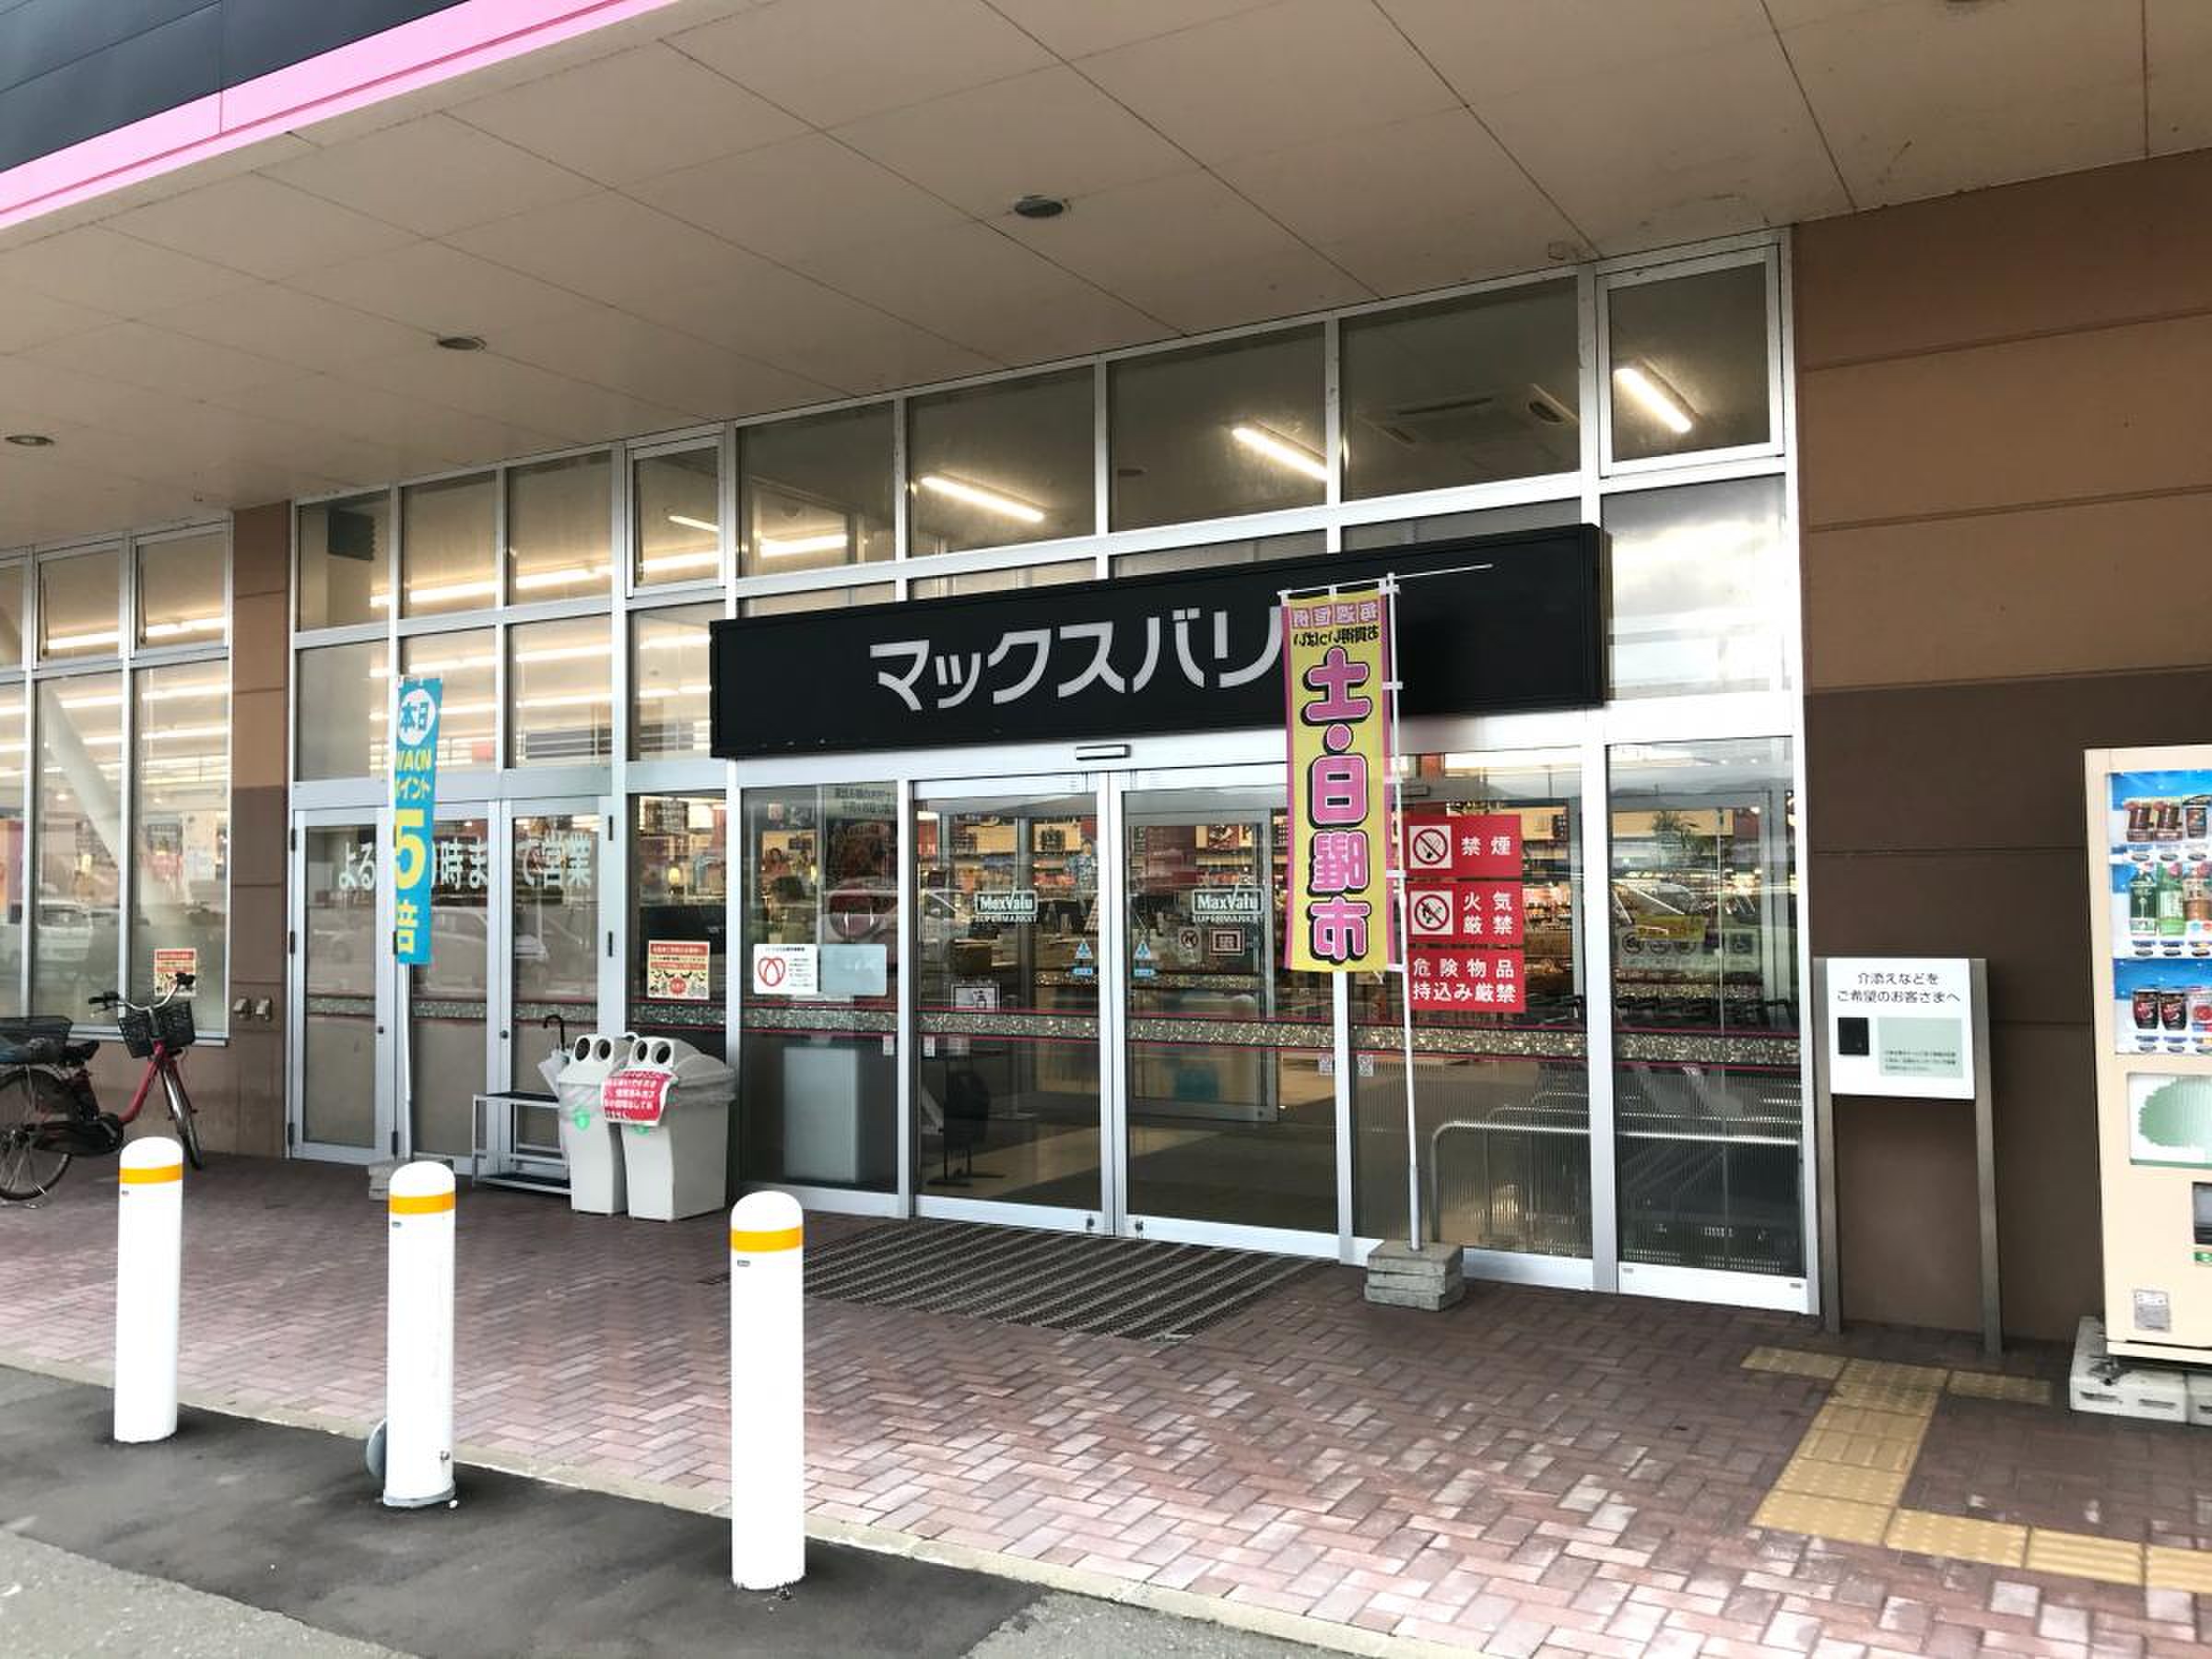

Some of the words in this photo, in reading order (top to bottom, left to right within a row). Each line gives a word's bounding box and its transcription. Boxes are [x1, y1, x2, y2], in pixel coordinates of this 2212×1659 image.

[870, 607, 1284, 711] マックスバリ
[395, 778, 430, 799] イント
[1461, 836, 1512, 856] 禁煙
[980, 894, 1033, 911] MaxValu
[1197, 890, 1259, 910] MaxValu
[1463, 891, 1512, 912] 火気
[1463, 915, 1513, 935] 厳禁
[1413, 958, 1514, 979] 危険物品
[1857, 972, 1939, 985] 介添えなどを
[1413, 982, 1516, 1004] 持込み厳禁
[1837, 990, 1961, 1004] ご希望のお客さまへ
